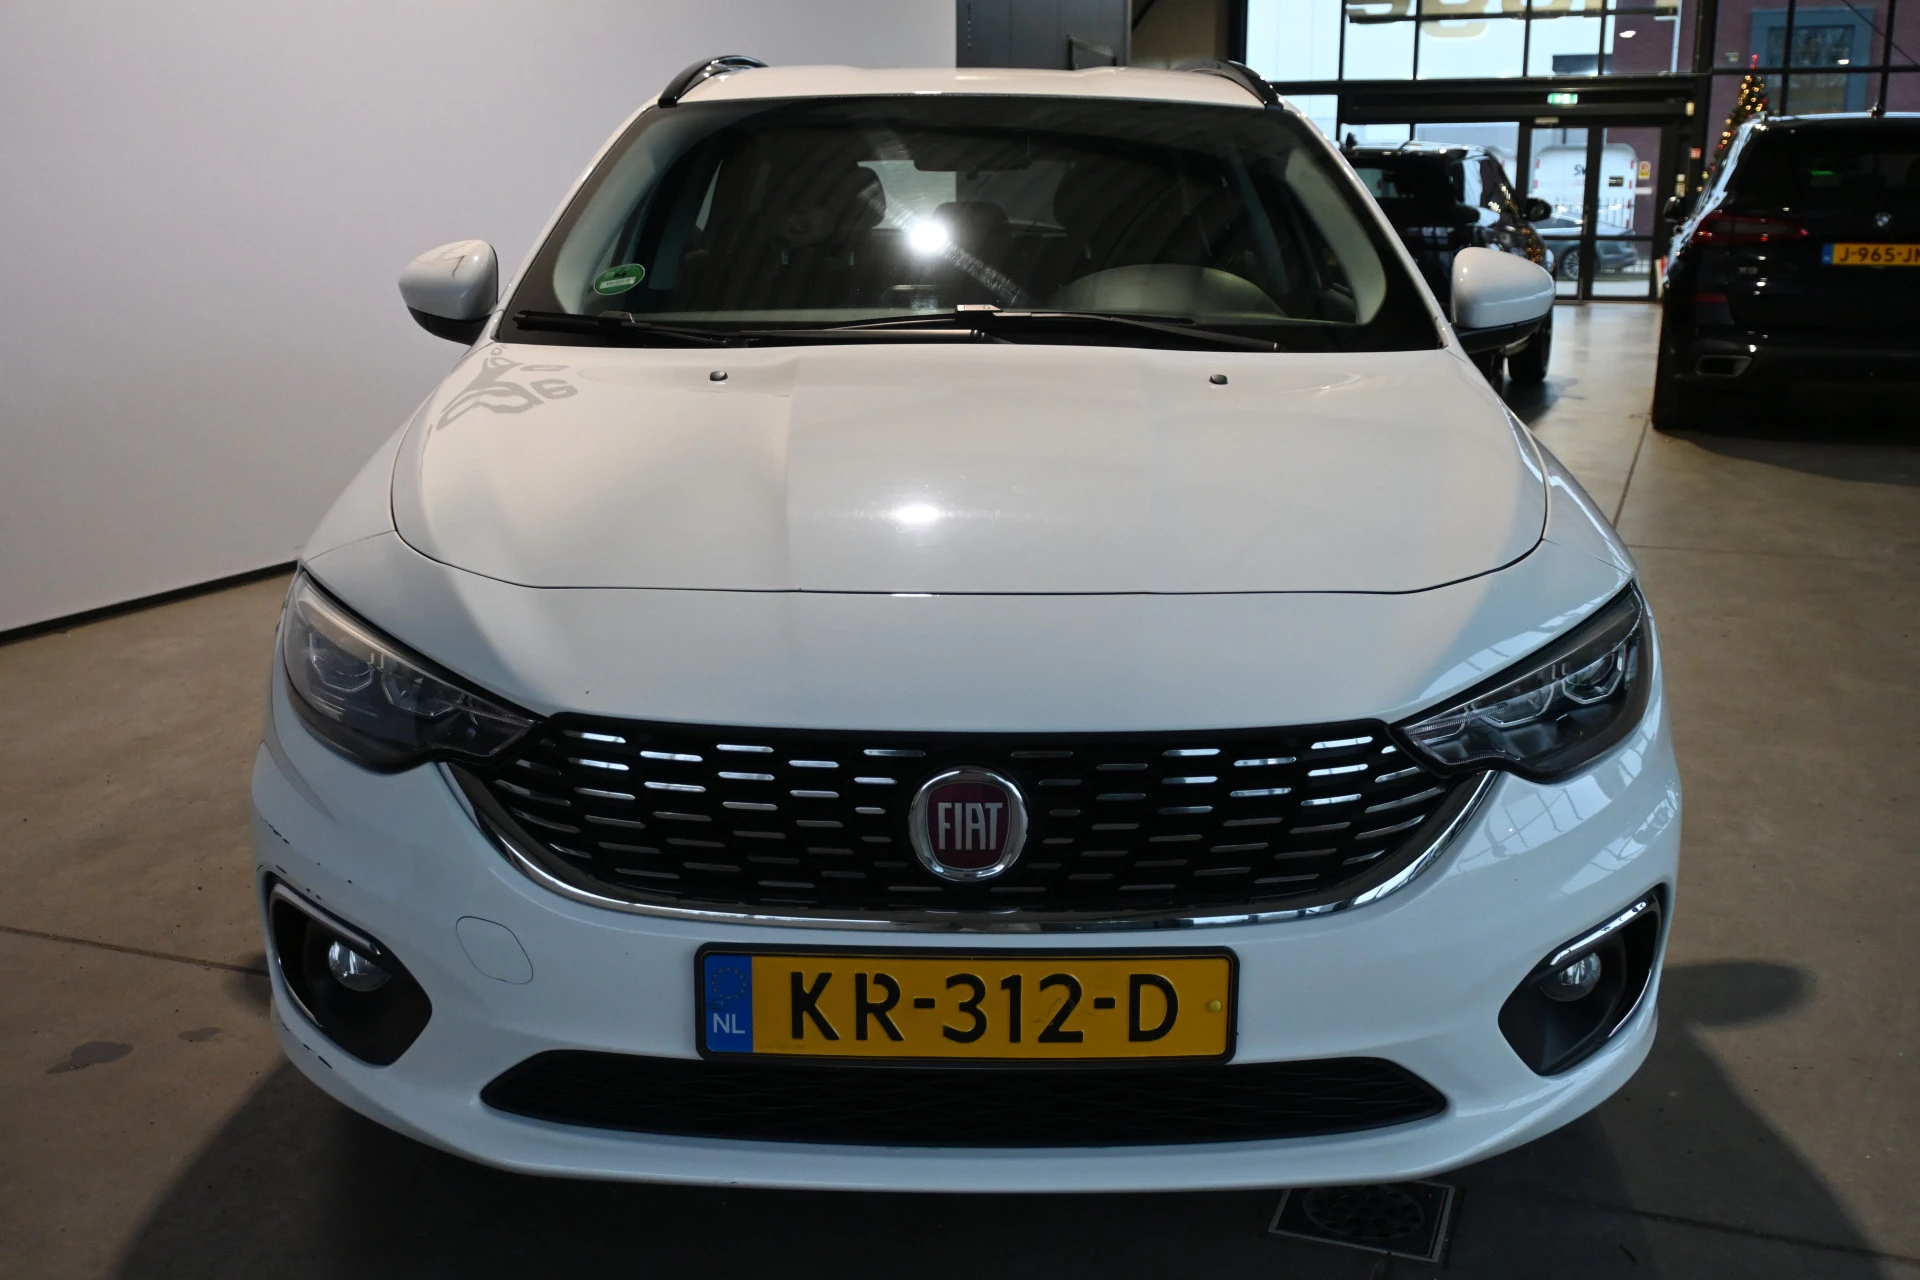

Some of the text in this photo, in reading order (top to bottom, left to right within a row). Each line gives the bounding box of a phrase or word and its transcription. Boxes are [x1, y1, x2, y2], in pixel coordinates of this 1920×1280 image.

[937, 802, 1003, 851] FIAT
[713, 1012, 745, 1034] NL
[790, 971, 1179, 1043] KR-312-D
